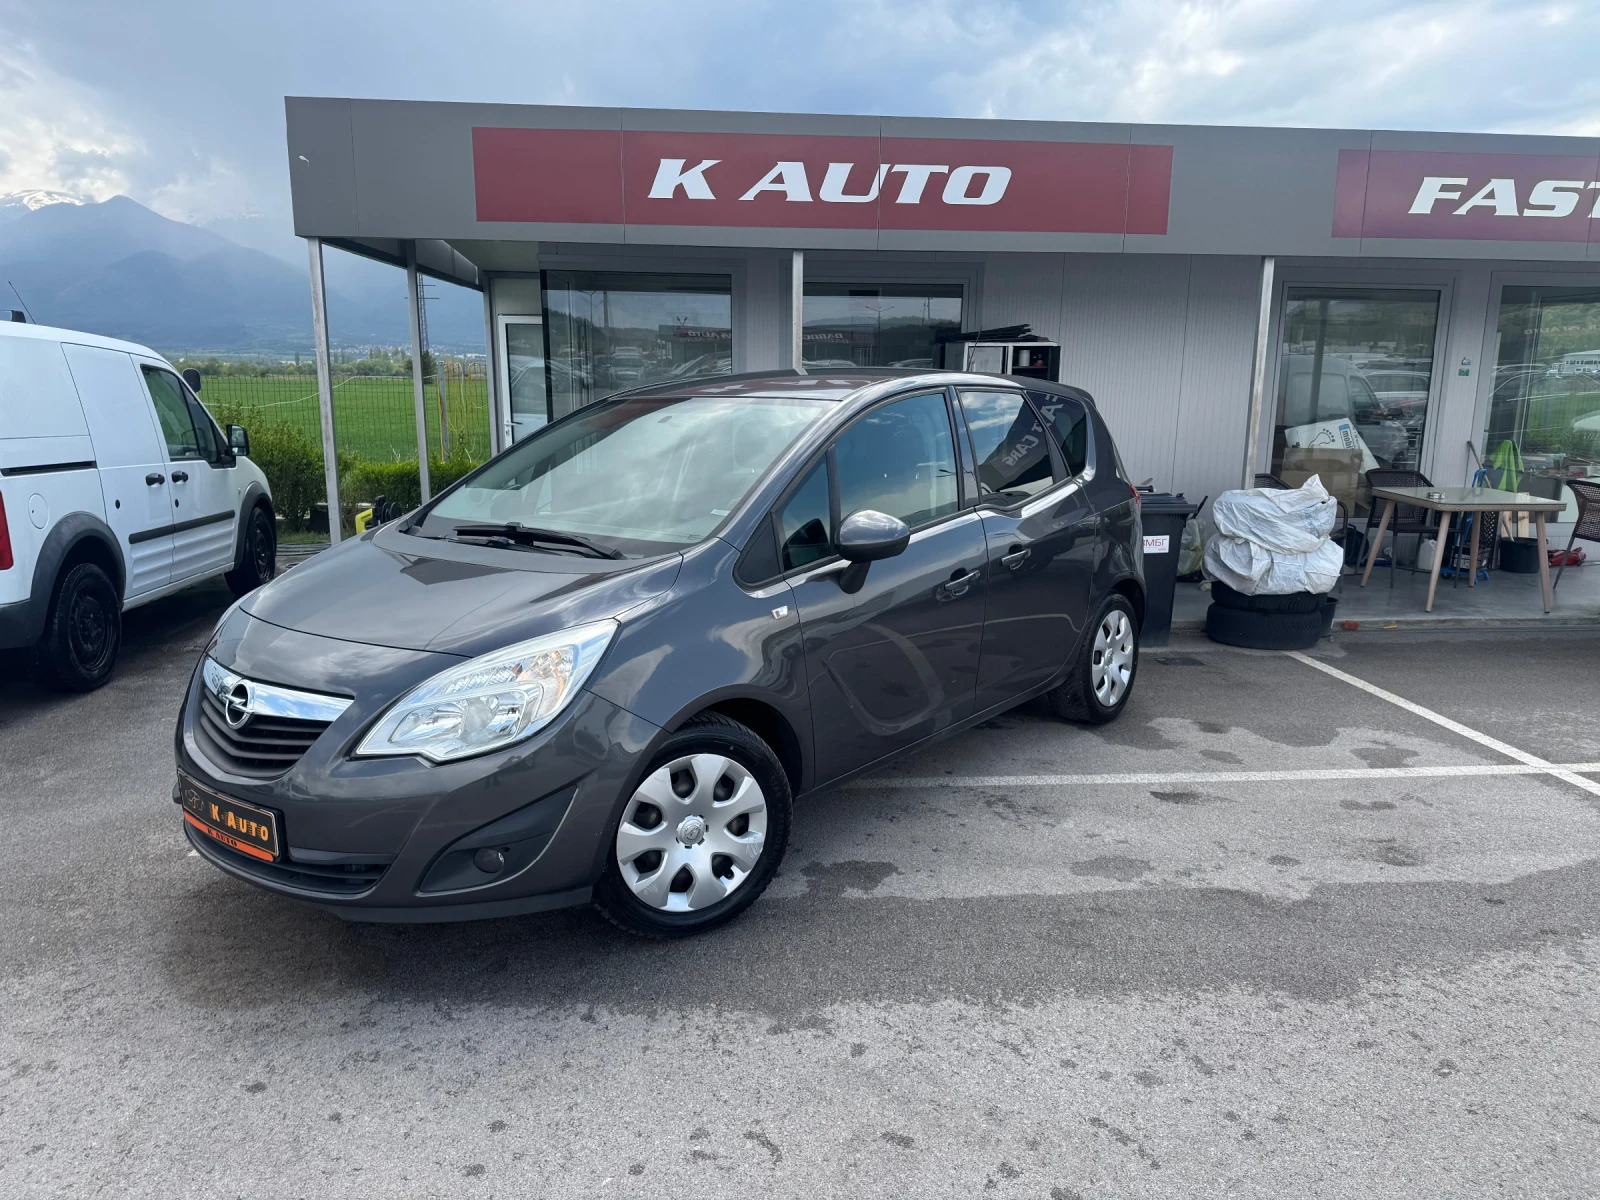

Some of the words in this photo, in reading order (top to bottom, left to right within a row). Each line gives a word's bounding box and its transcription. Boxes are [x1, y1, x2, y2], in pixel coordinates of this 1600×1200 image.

[648, 158, 723, 200] K
[737, 161, 1013, 206] AUTO
[1407, 176, 1600, 219] FAS
[211, 803, 220, 822] K
